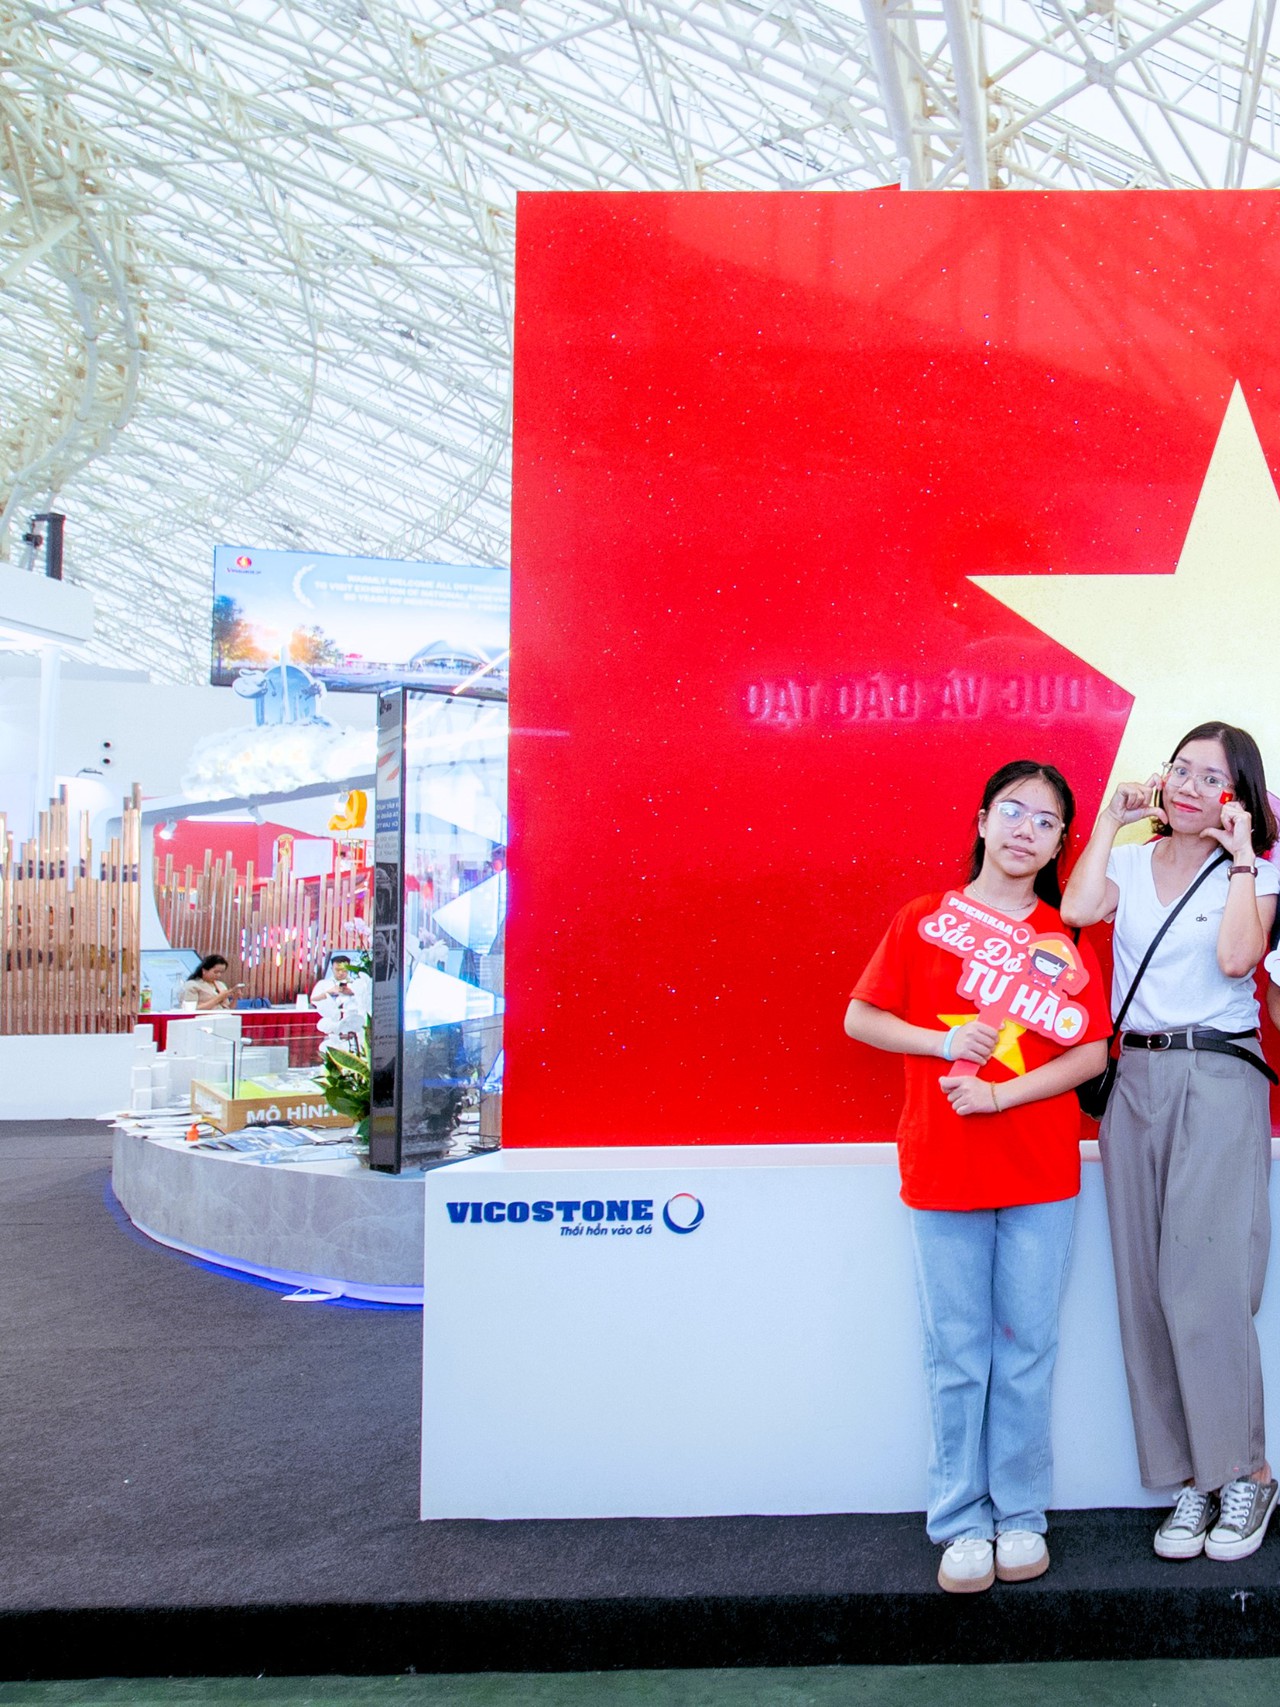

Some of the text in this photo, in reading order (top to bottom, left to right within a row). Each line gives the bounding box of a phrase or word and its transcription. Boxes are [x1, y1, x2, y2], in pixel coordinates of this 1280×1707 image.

[947, 897, 1014, 936] PHENIKAA
[924, 913, 975, 951] Sắc
[974, 937, 1026, 973] Đỏ
[963, 960, 1083, 1039] TỰ HÀO
[246, 1104, 281, 1124] MÔ
[446, 1199, 653, 1224] VICOSTONE
[636, 1223, 652, 1235] đá
